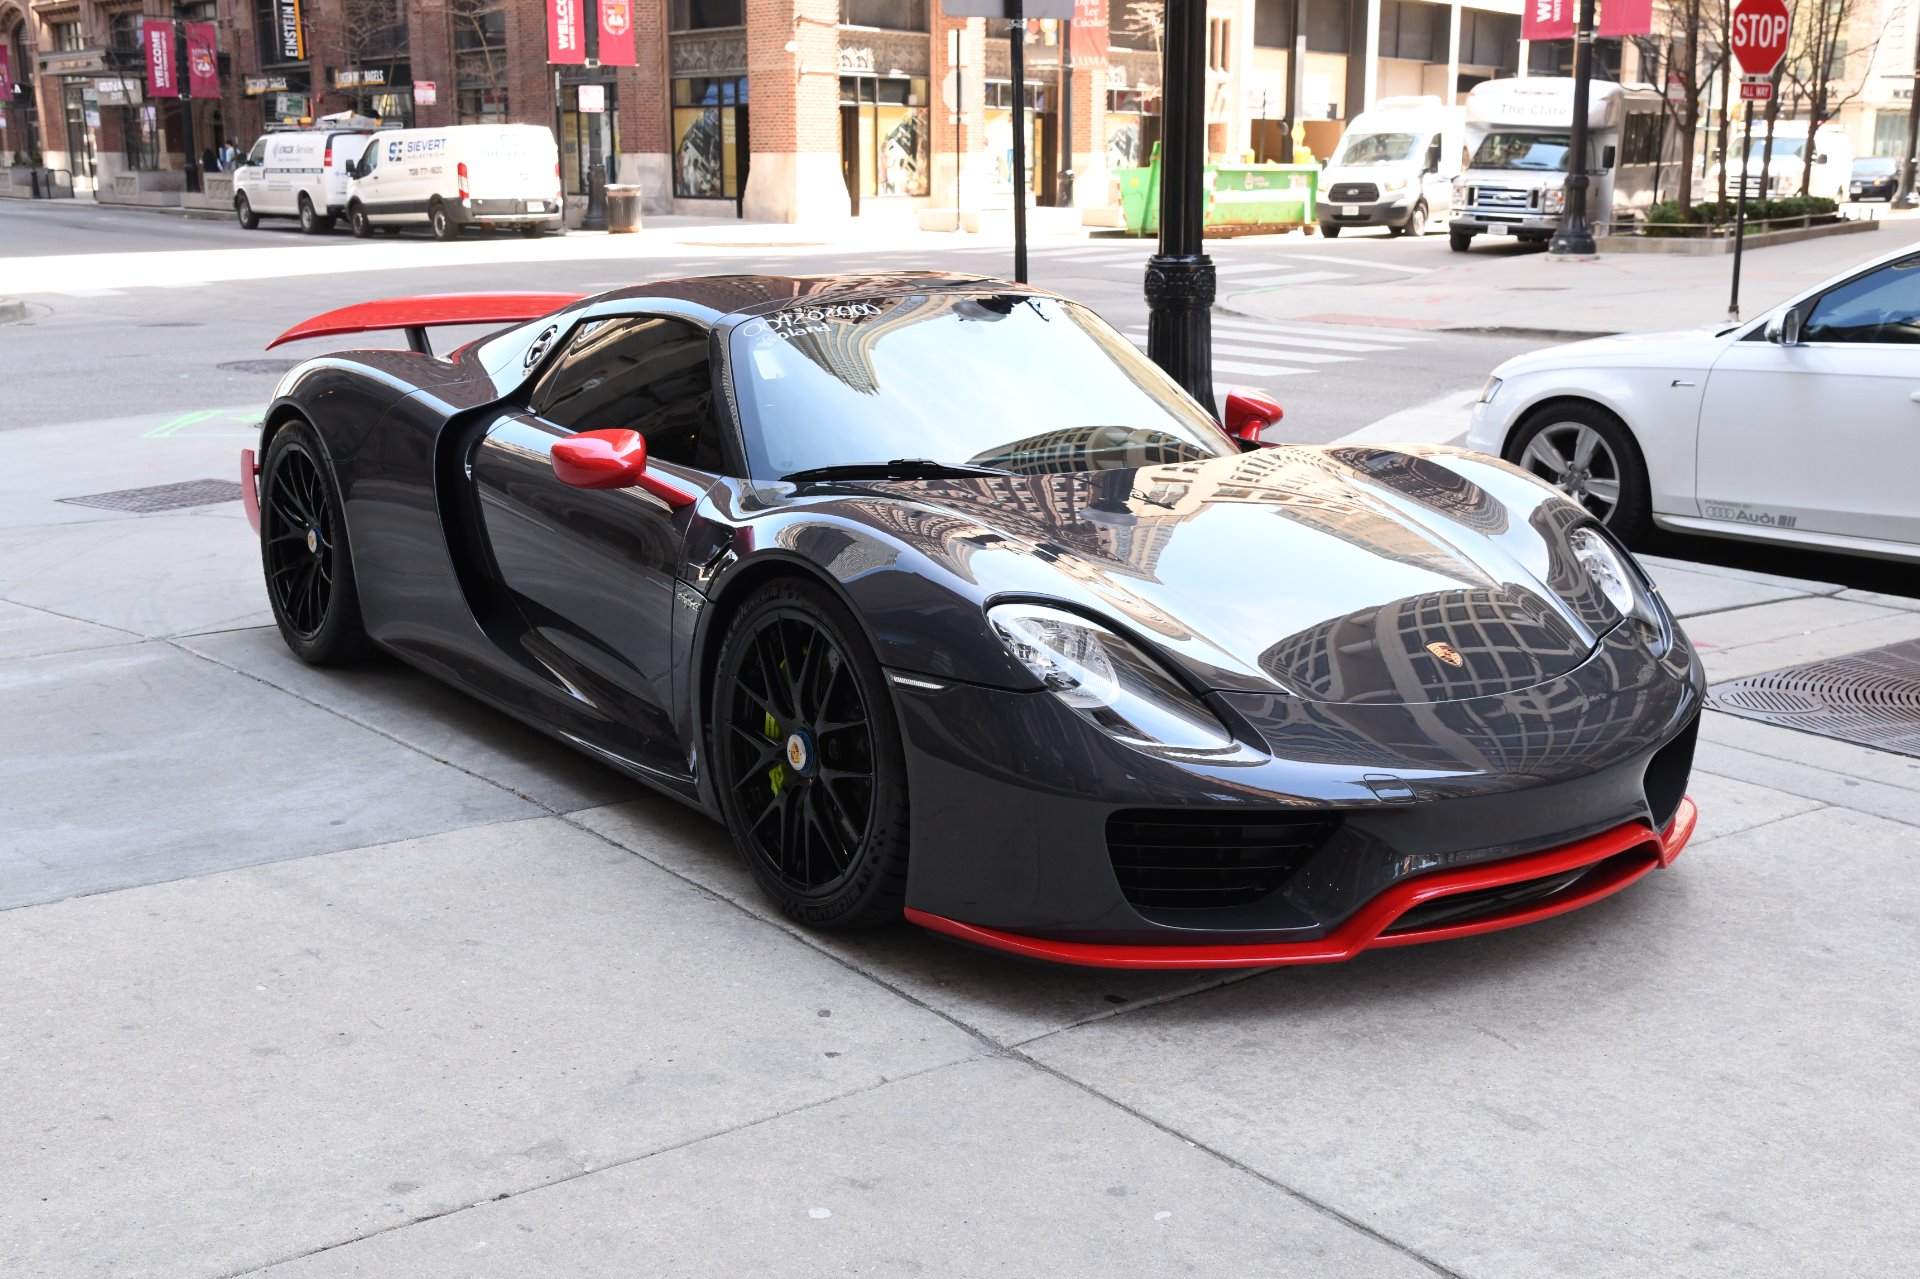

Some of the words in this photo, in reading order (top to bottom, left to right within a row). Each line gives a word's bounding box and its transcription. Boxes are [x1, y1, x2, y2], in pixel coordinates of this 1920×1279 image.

[282, 6, 298, 57] EINSTEIN
[1735, 13, 1787, 48] STOP
[151, 31, 165, 88] WELCOME
[1072, 55, 1108, 66] LUMA
[364, 70, 384, 82] BAGELS
[1742, 86, 1754, 97] ALL
[1756, 86, 1770, 97] WAY
[1501, 104, 1525, 114] The
[1530, 104, 1568, 116] Clare
[407, 138, 447, 153] SIEVERT
[1736, 510, 1776, 526] Audi
